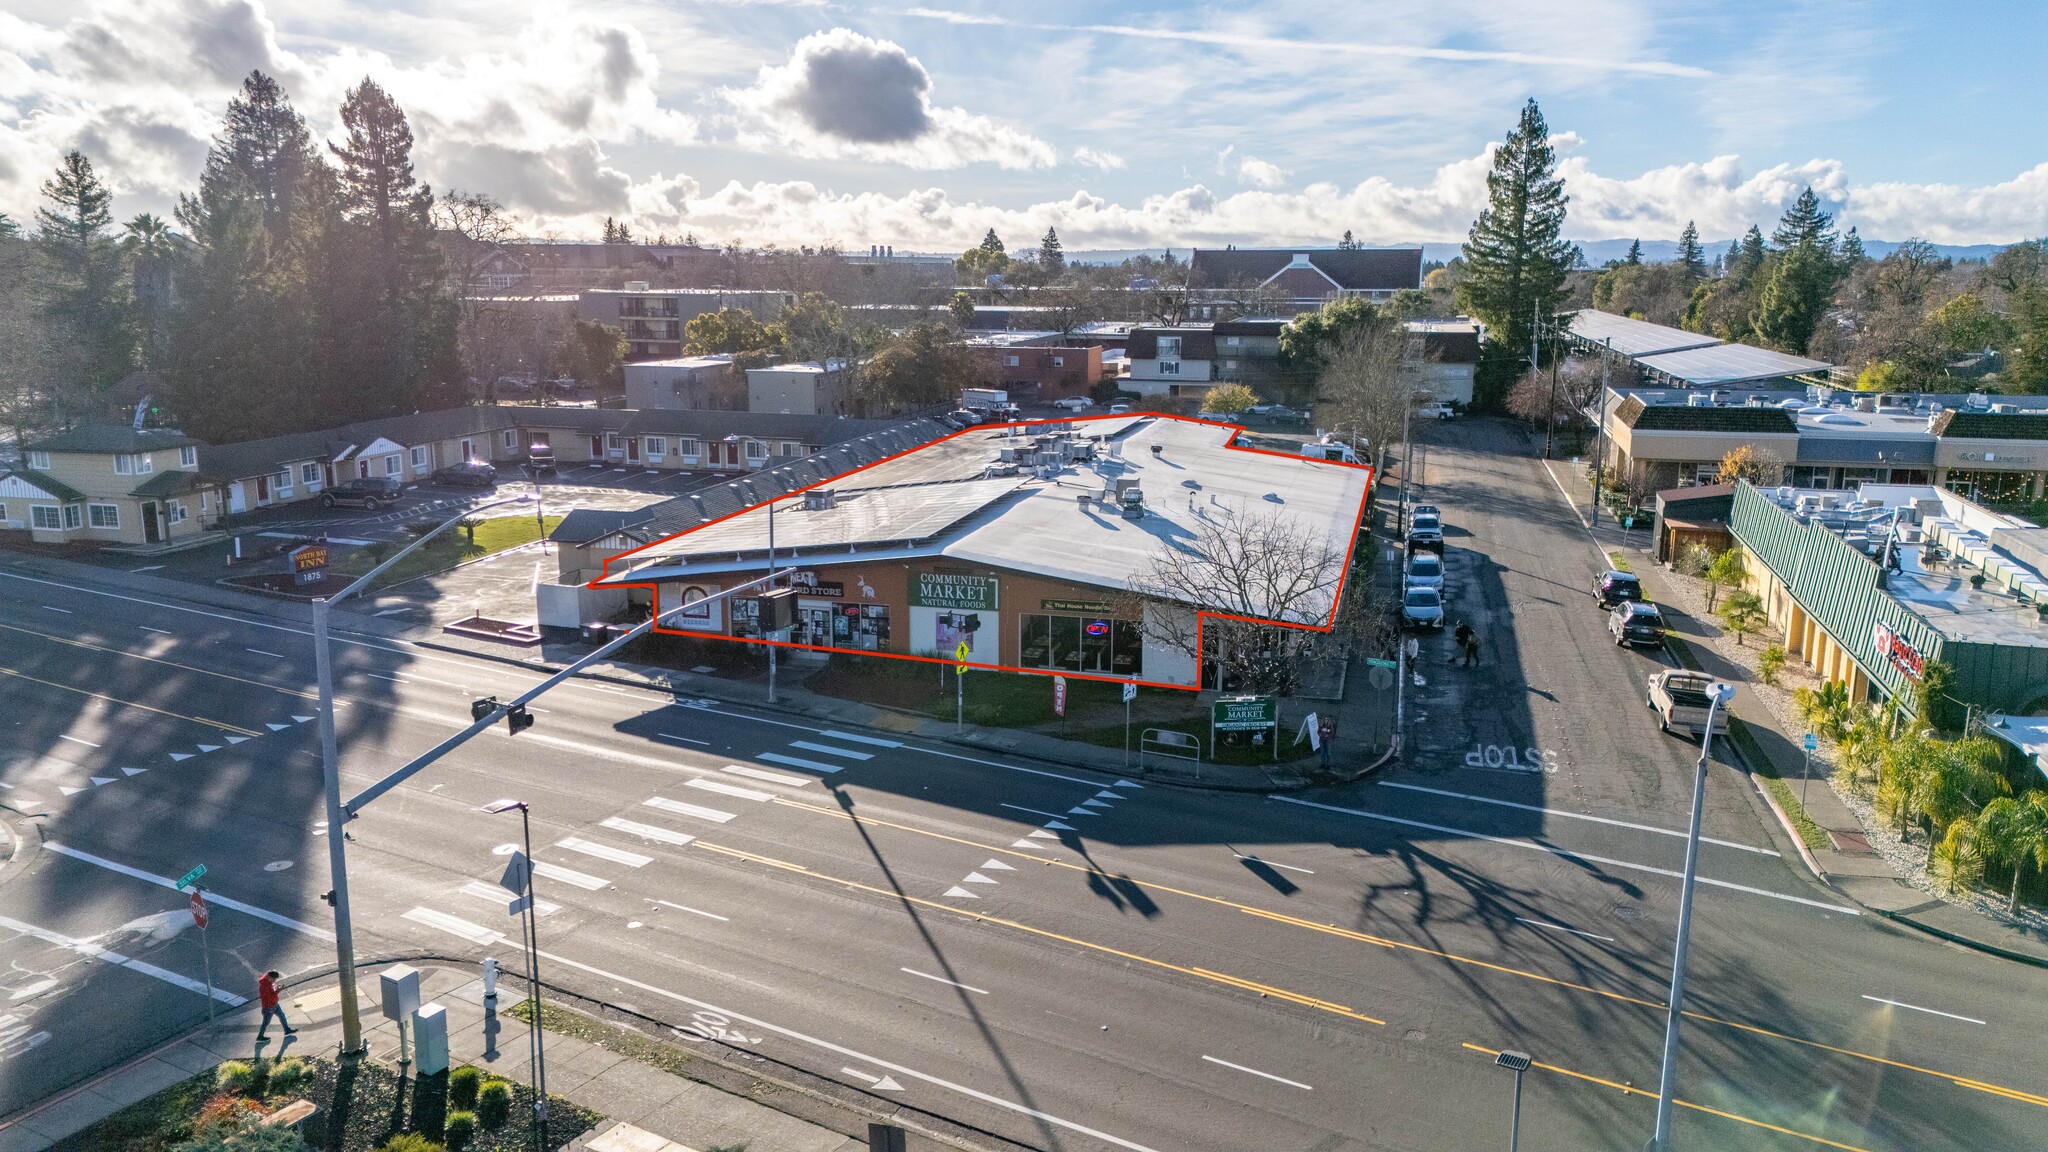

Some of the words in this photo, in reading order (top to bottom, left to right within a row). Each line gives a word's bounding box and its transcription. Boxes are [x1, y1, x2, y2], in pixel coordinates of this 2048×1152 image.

[295, 552, 315, 560] NORTH
[300, 557, 324, 568] INN
[303, 572, 321, 581] 1875
[790, 571, 814, 587] NEXT
[920, 573, 986, 586] COMMUNITY
[774, 585, 810, 594] REORD
[811, 588, 842, 596] STORE
[920, 583, 987, 600] MARKET
[921, 598, 957, 608] NATURAL
[960, 600, 986, 609] FOODS
[1086, 624, 1109, 634] OPN
[1227, 710, 1265, 719] MARKET
[191, 900, 207, 918] STOP
